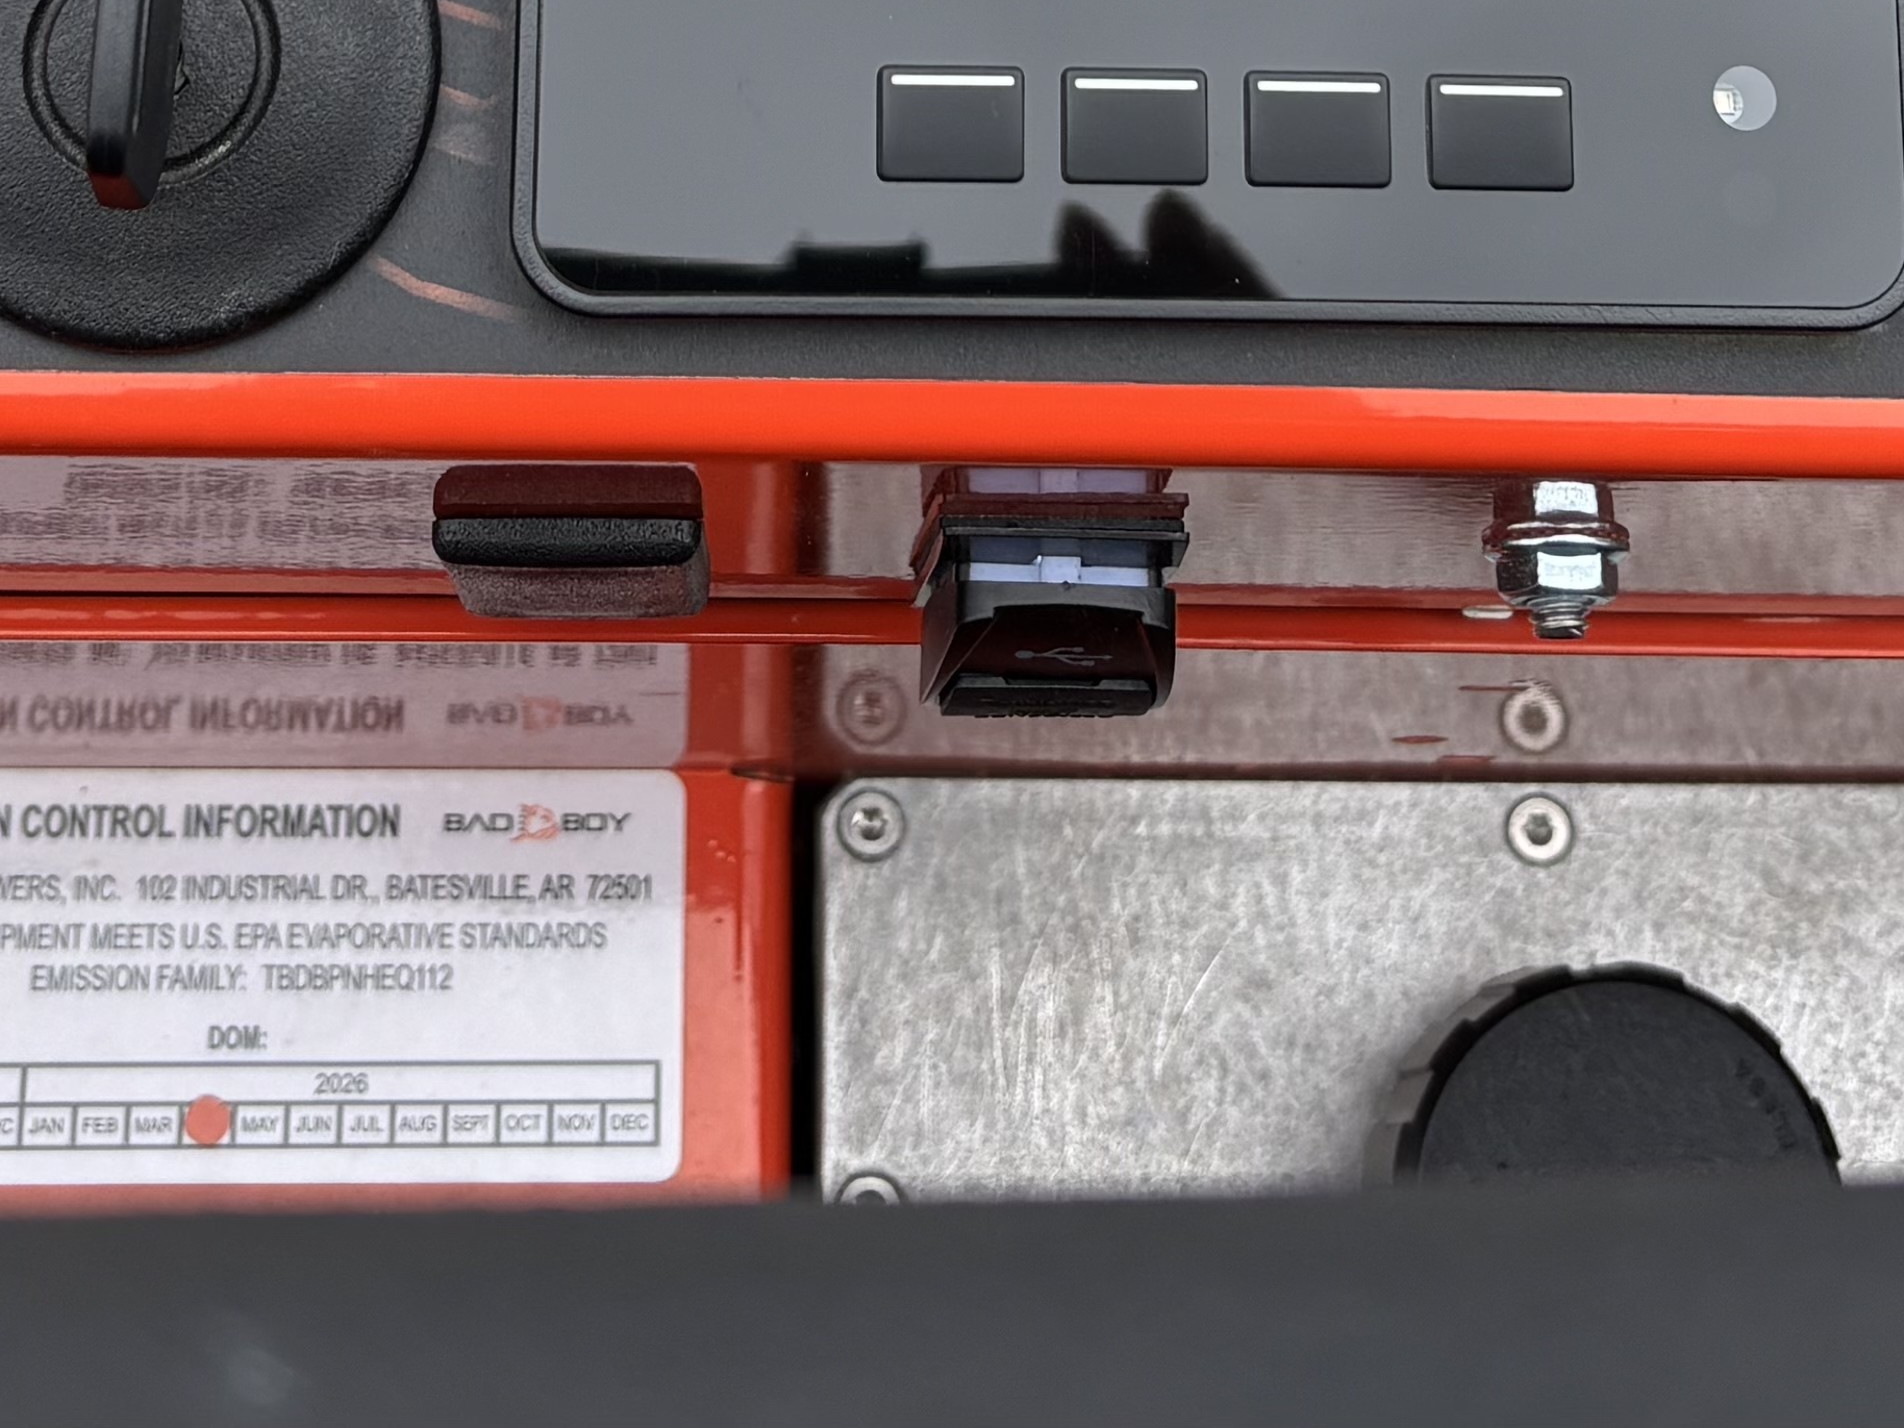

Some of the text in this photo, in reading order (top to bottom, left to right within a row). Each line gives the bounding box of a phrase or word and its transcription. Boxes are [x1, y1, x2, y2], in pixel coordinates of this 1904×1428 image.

[21, 804, 176, 838] CONTROL
[182, 804, 401, 838] INFORMATION
[443, 812, 632, 832] BAD BOY
[73, 875, 122, 901] INC.
[136, 875, 176, 901] 102
[182, 875, 325, 901] INDUSTRIAL
[385, 875, 537, 904] BATESVILLE,
[539, 875, 575, 900] AR
[586, 875, 653, 900] 72501
[88, 923, 175, 950] MEETS
[180, 923, 228, 950] U.S.
[234, 922, 281, 949] EPA
[286, 922, 455, 949] EVAPORATIVE
[459, 922, 608, 949] STANDARDS
[30, 964, 149, 991] EMISSION
[155, 964, 247, 991] FAMILY:
[208, 1025, 267, 1050] DOM:
[314, 1072, 369, 1095] 2026
[28, 1117, 65, 1135] JAN
[81, 1116, 119, 1135] FEB
[134, 1116, 173, 1134] MAR
[240, 1115, 279, 1134] MAY
[295, 1115, 332, 1134] JUN
[349, 1114, 384, 1133] JUL
[398, 1114, 437, 1133] AUG
[451, 1114, 490, 1133] SEPT
[505, 1113, 542, 1132] OCT
[557, 1113, 595, 1132] NOV
[610, 1113, 649, 1132] DEC
